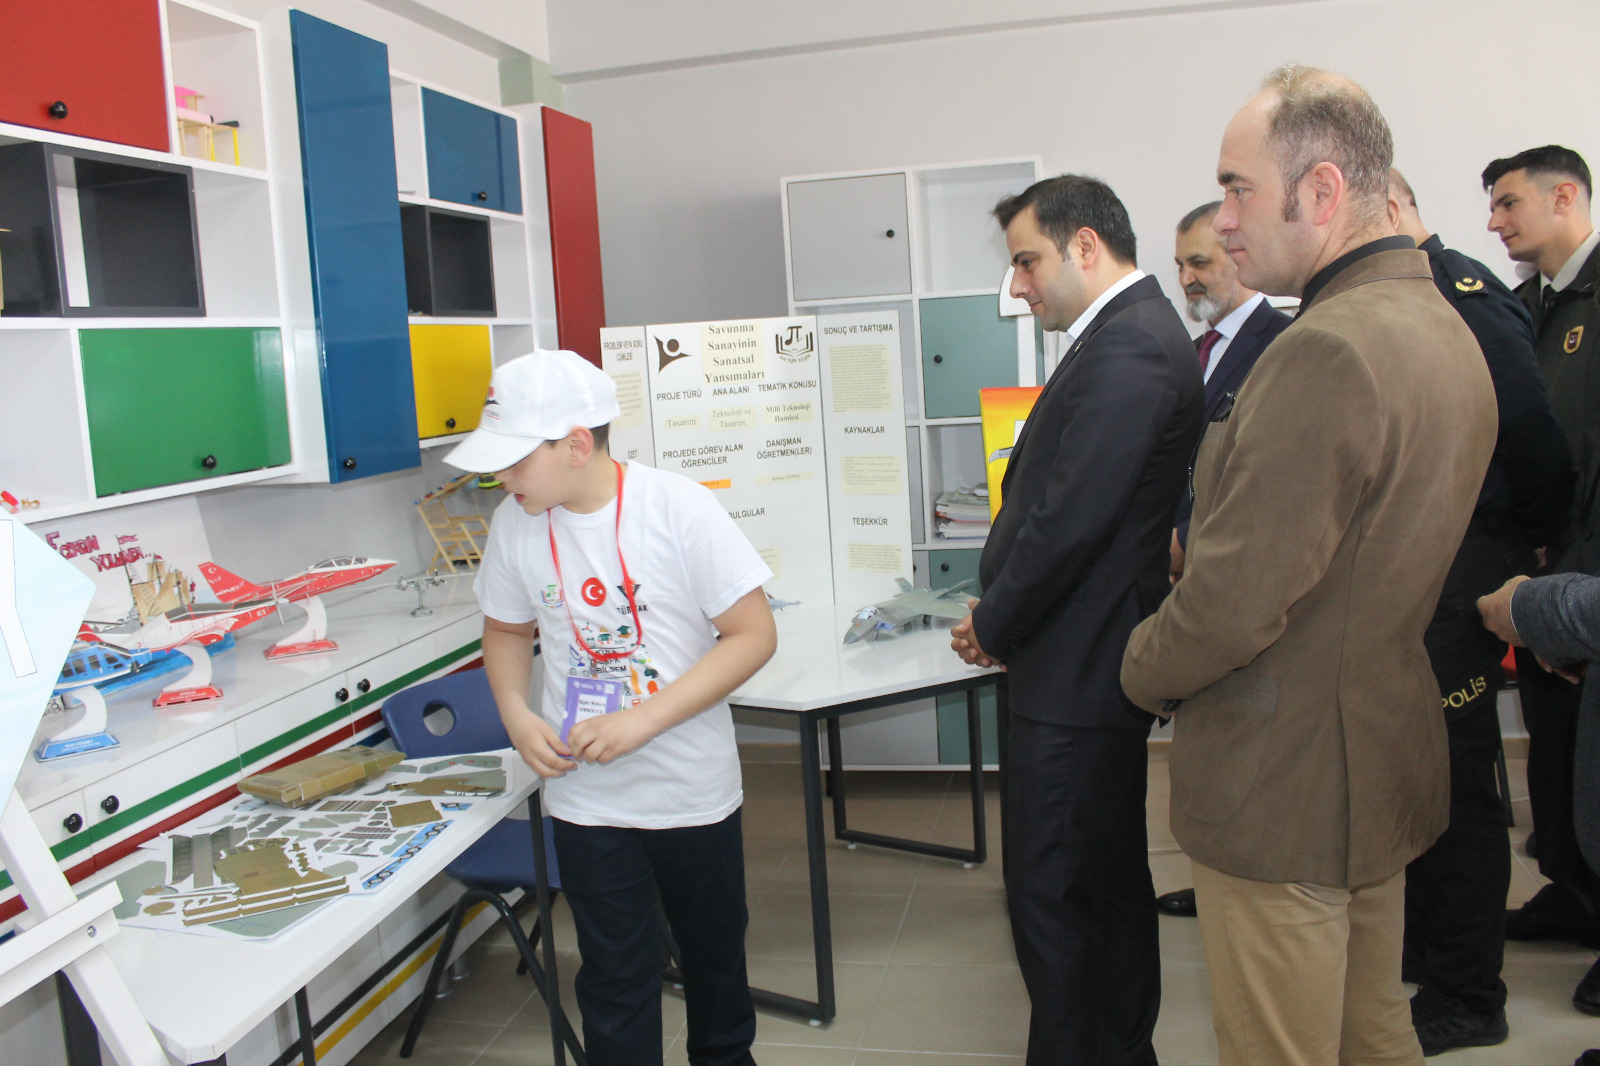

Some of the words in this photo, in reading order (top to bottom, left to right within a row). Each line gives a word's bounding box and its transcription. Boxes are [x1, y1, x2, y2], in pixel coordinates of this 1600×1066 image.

[708, 324, 754, 335] Savunma
[824, 326, 847, 335] SONUÇ
[848, 325, 858, 333] VE
[859, 324, 894, 333] TARTIŞMA
[603, 341, 622, 350] PROBLEM
[623, 341, 633, 349] VEYA
[633, 339, 644, 349] SORU
[708, 338, 757, 352] Sanayinin
[713, 354, 754, 367] Sanatsal
[705, 370, 765, 384] Yansımaları
[712, 387, 728, 397] ANA
[729, 386, 750, 395] ALANI
[758, 381, 788, 392] TEMATİK
[788, 380, 817, 390] KONUSU
[657, 391, 681, 401] PROJE
[682, 389, 702, 399] TÜRÜ
[782, 403, 811, 412] Teknoloji
[712, 409, 743, 419] Teknoloji
[774, 413, 800, 423] Hamlesi
[667, 417, 697, 428] Tasarım
[720, 419, 746, 429] Tasarım
[844, 426, 885, 434] KAYNAKLAR
[766, 437, 802, 449] DANIŞMAN
[627, 449, 638, 460] ÖZET
[663, 448, 696, 459] PROJEDE
[698, 444, 724, 456] GÖREV
[724, 443, 744, 453] ALAN
[756, 446, 813, 460] ÖĞRETMEN(LER)
[681, 456, 728, 469] ÖĞRENCİLER
[852, 517, 888, 527] TEŞEKKÜR
[596, 665, 628, 674] BİLSEM
